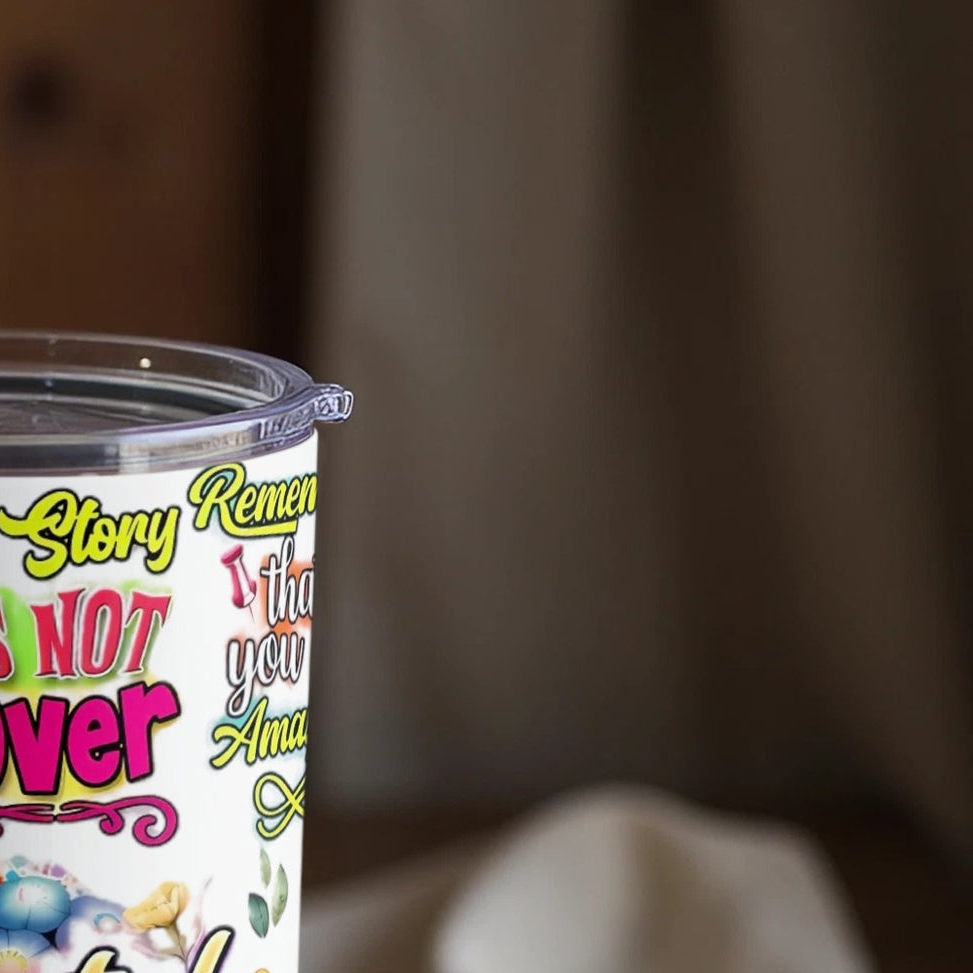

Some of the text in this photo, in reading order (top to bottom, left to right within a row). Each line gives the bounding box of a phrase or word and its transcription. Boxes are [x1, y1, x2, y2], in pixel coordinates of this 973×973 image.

[259, 533, 315, 628] tha
[29, 586, 173, 682] NOT
[225, 630, 306, 719] you
[210, 696, 309, 769] Ama
